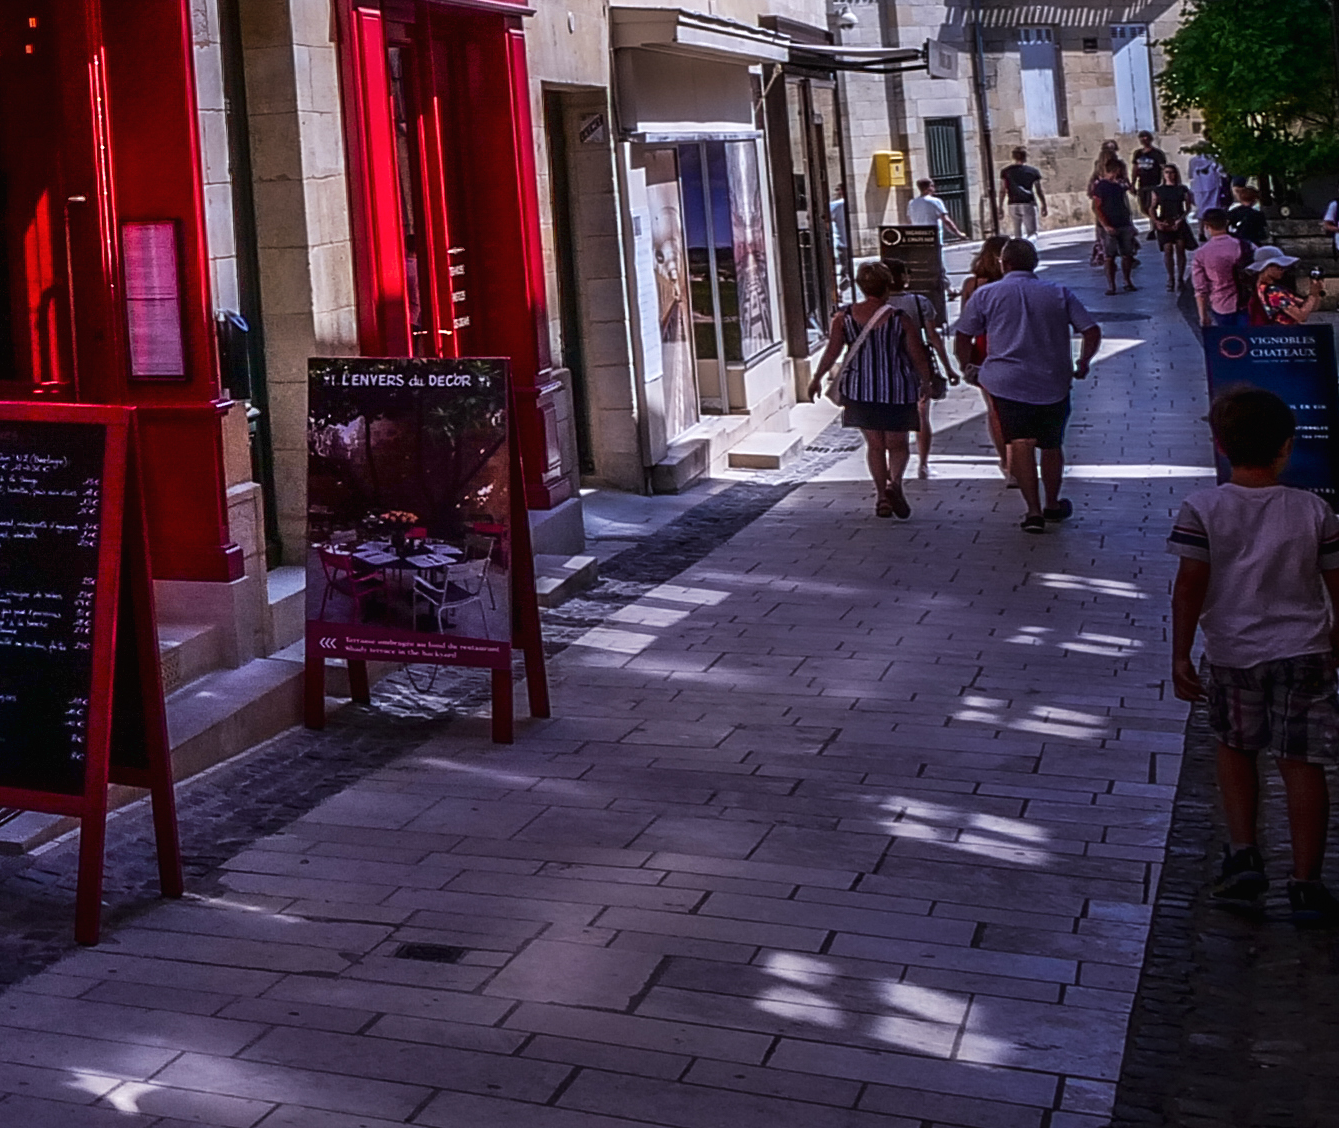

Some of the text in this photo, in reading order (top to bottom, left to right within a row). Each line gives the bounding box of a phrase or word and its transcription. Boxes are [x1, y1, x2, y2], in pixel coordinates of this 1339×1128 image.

[1249, 336, 1316, 345] VIGNOBLES
[1249, 348, 1317, 358] CHATEAUX
[341, 373, 405, 388] L'ENVERS
[408, 374, 427, 388] du
